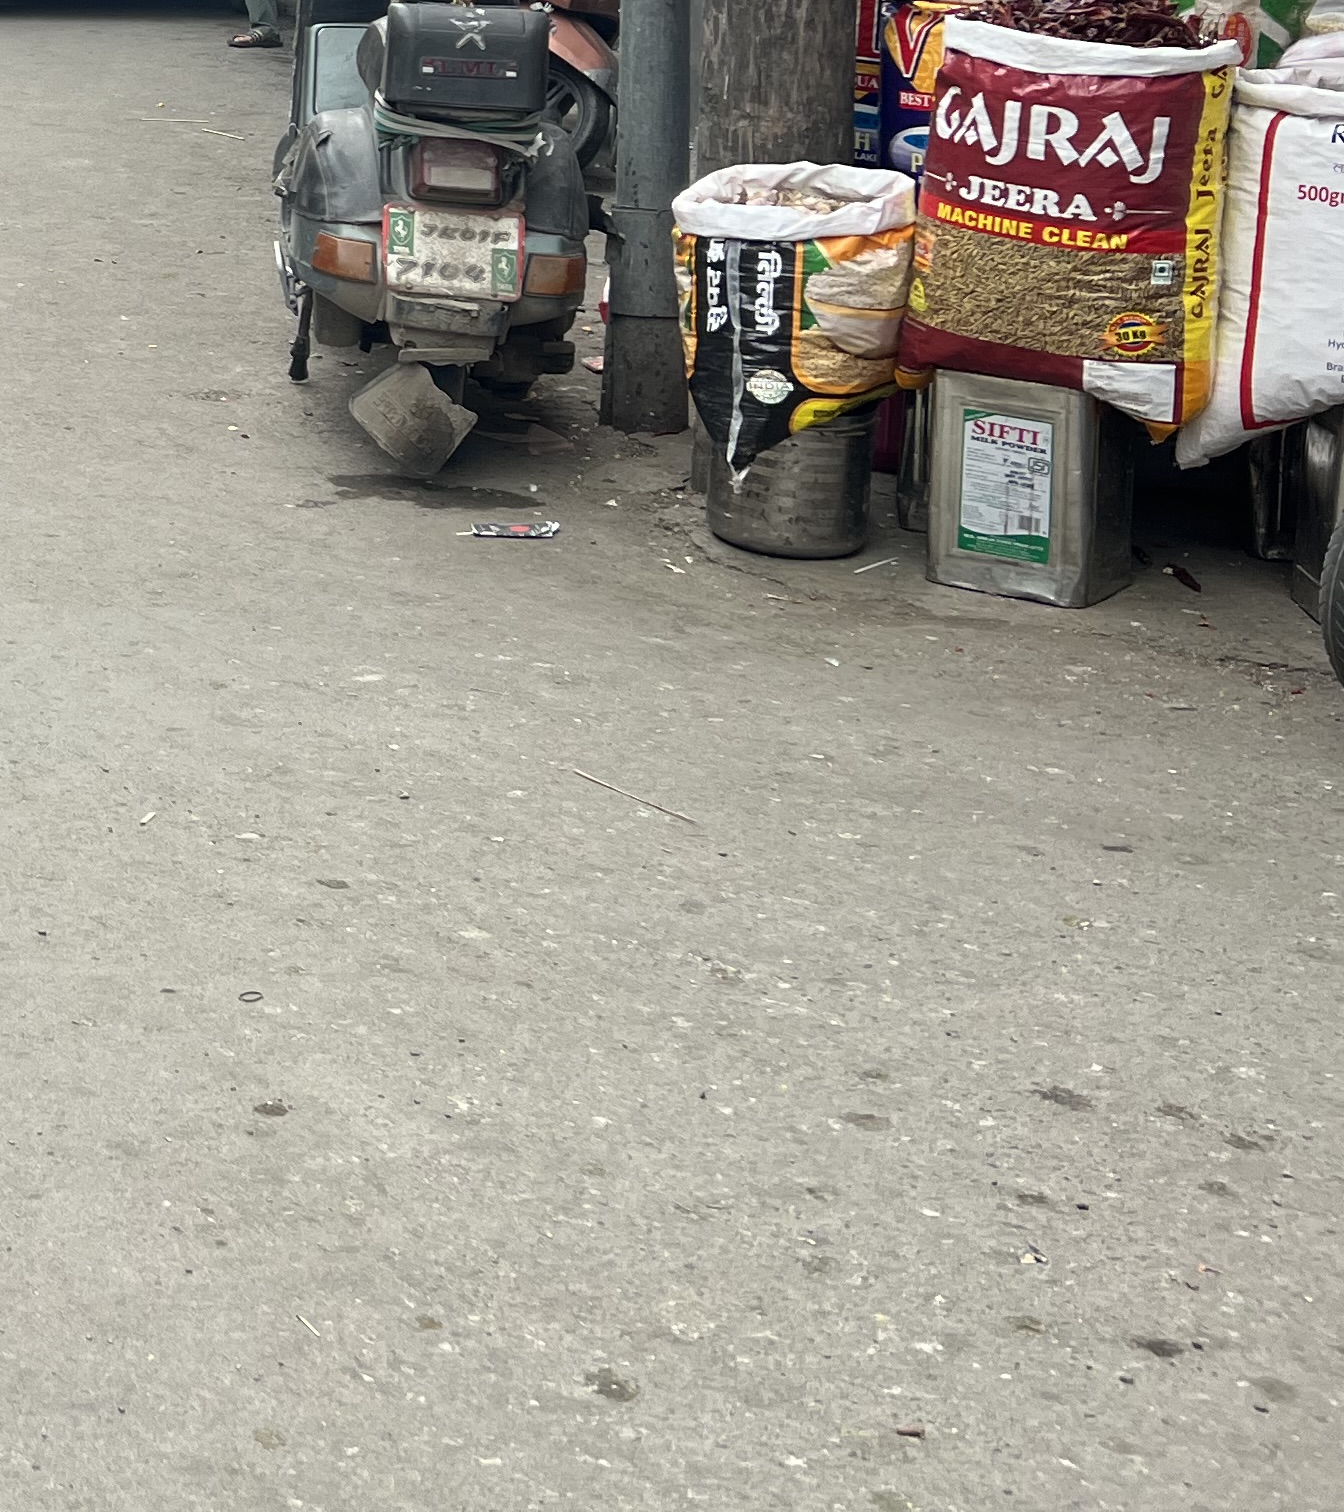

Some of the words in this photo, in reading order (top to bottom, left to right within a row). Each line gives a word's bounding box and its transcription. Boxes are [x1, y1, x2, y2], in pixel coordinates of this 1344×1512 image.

[899, 91, 932, 108] BEST
[935, 85, 1171, 185] GAJRAJ
[1196, 126, 1217, 201] Jeera
[958, 174, 1098, 222] JEERA
[936, 202, 1034, 240] MACHINE
[1042, 224, 1128, 250] CLEAN
[1190, 228, 1212, 320] GAJRAJ
[970, 435, 998, 445] MILK
[1001, 440, 1048, 455] POWDER
[971, 419, 1041, 446] SIFTI
